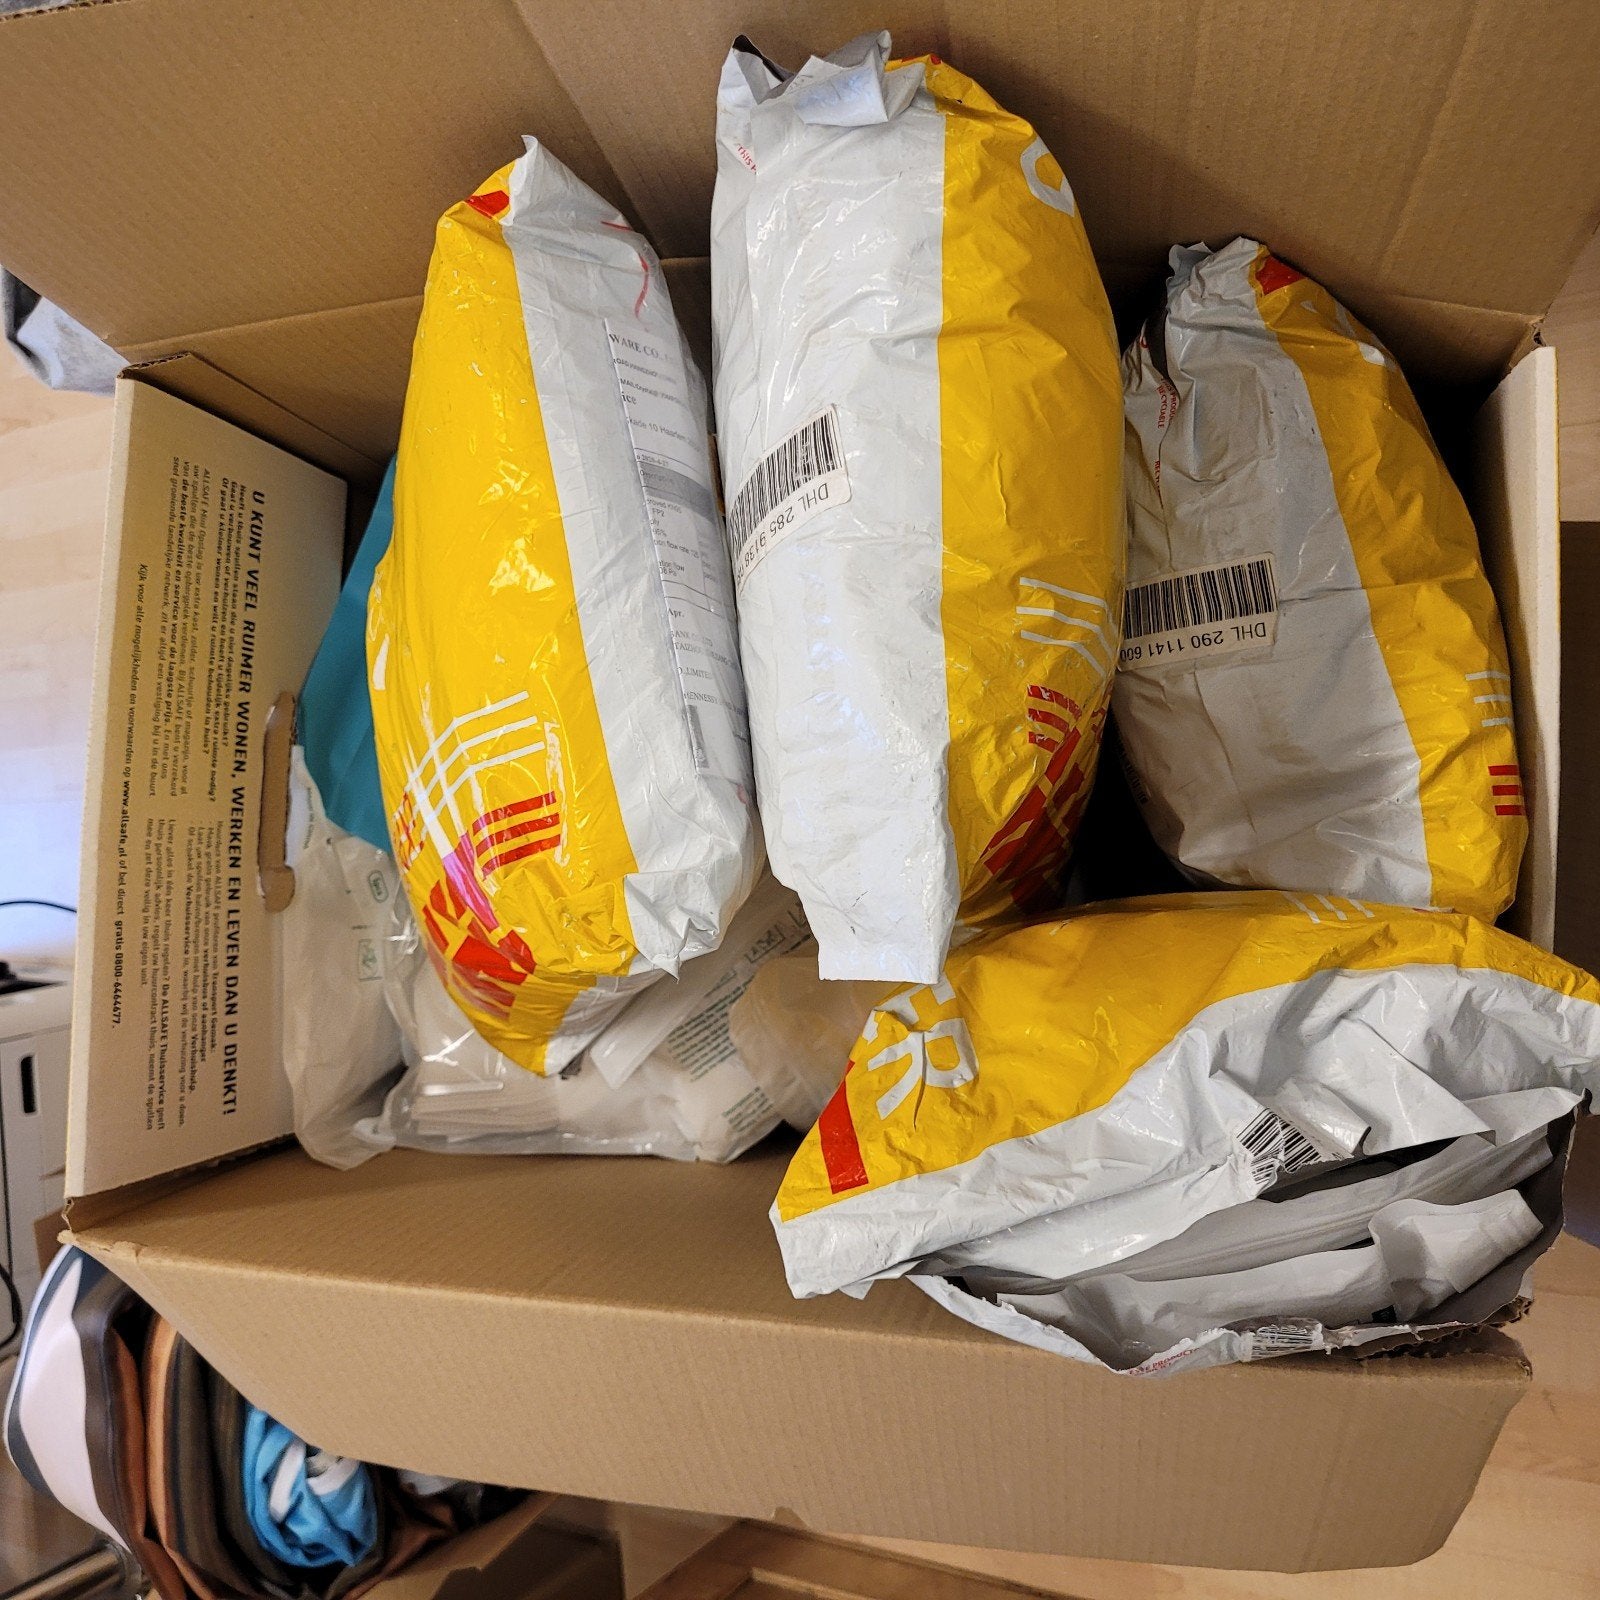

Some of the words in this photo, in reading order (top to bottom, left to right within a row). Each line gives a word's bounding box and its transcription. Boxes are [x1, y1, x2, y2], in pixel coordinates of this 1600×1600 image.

[179, 493, 188, 521] beste
[251, 490, 265, 505] U
[797, 482, 829, 512] DHL
[246, 510, 263, 563] KUNT
[769, 506, 795, 537] 285
[175, 522, 186, 567] kwaliteit
[744, 531, 767, 567] 9138
[136, 563, 147, 581] Kijk
[171, 583, 181, 620] service
[243, 568, 259, 612] VEEL
[135, 605, 145, 622] alle
[169, 622, 177, 644] voor
[1190, 630, 1224, 649] 290
[1230, 622, 1266, 642] DHL
[127, 624, 143, 690] mogelijkheden
[237, 620, 256, 693] RUIMER
[1148, 638, 1185, 657] 1141
[164, 660, 176, 698] laagste
[128, 693, 135, 704] en
[124, 706, 136, 764] voorwaarden
[230, 700, 250, 778] WONEN,
[161, 742, 170, 760] met
[121, 766, 130, 777] op
[118, 780, 131, 857] www.allsafe.nl
[228, 786, 245, 868] WERKEN
[117, 871, 126, 886] bel
[118, 860, 126, 869] of
[116, 888, 125, 915] direct
[227, 877, 241, 900] EN
[112, 920, 124, 950] gratis
[225, 909, 240, 967] LEVEN
[224, 976, 238, 1016] DAN
[224, 1023, 237, 1036] U
[222, 1043, 237, 1115] DENKT!
